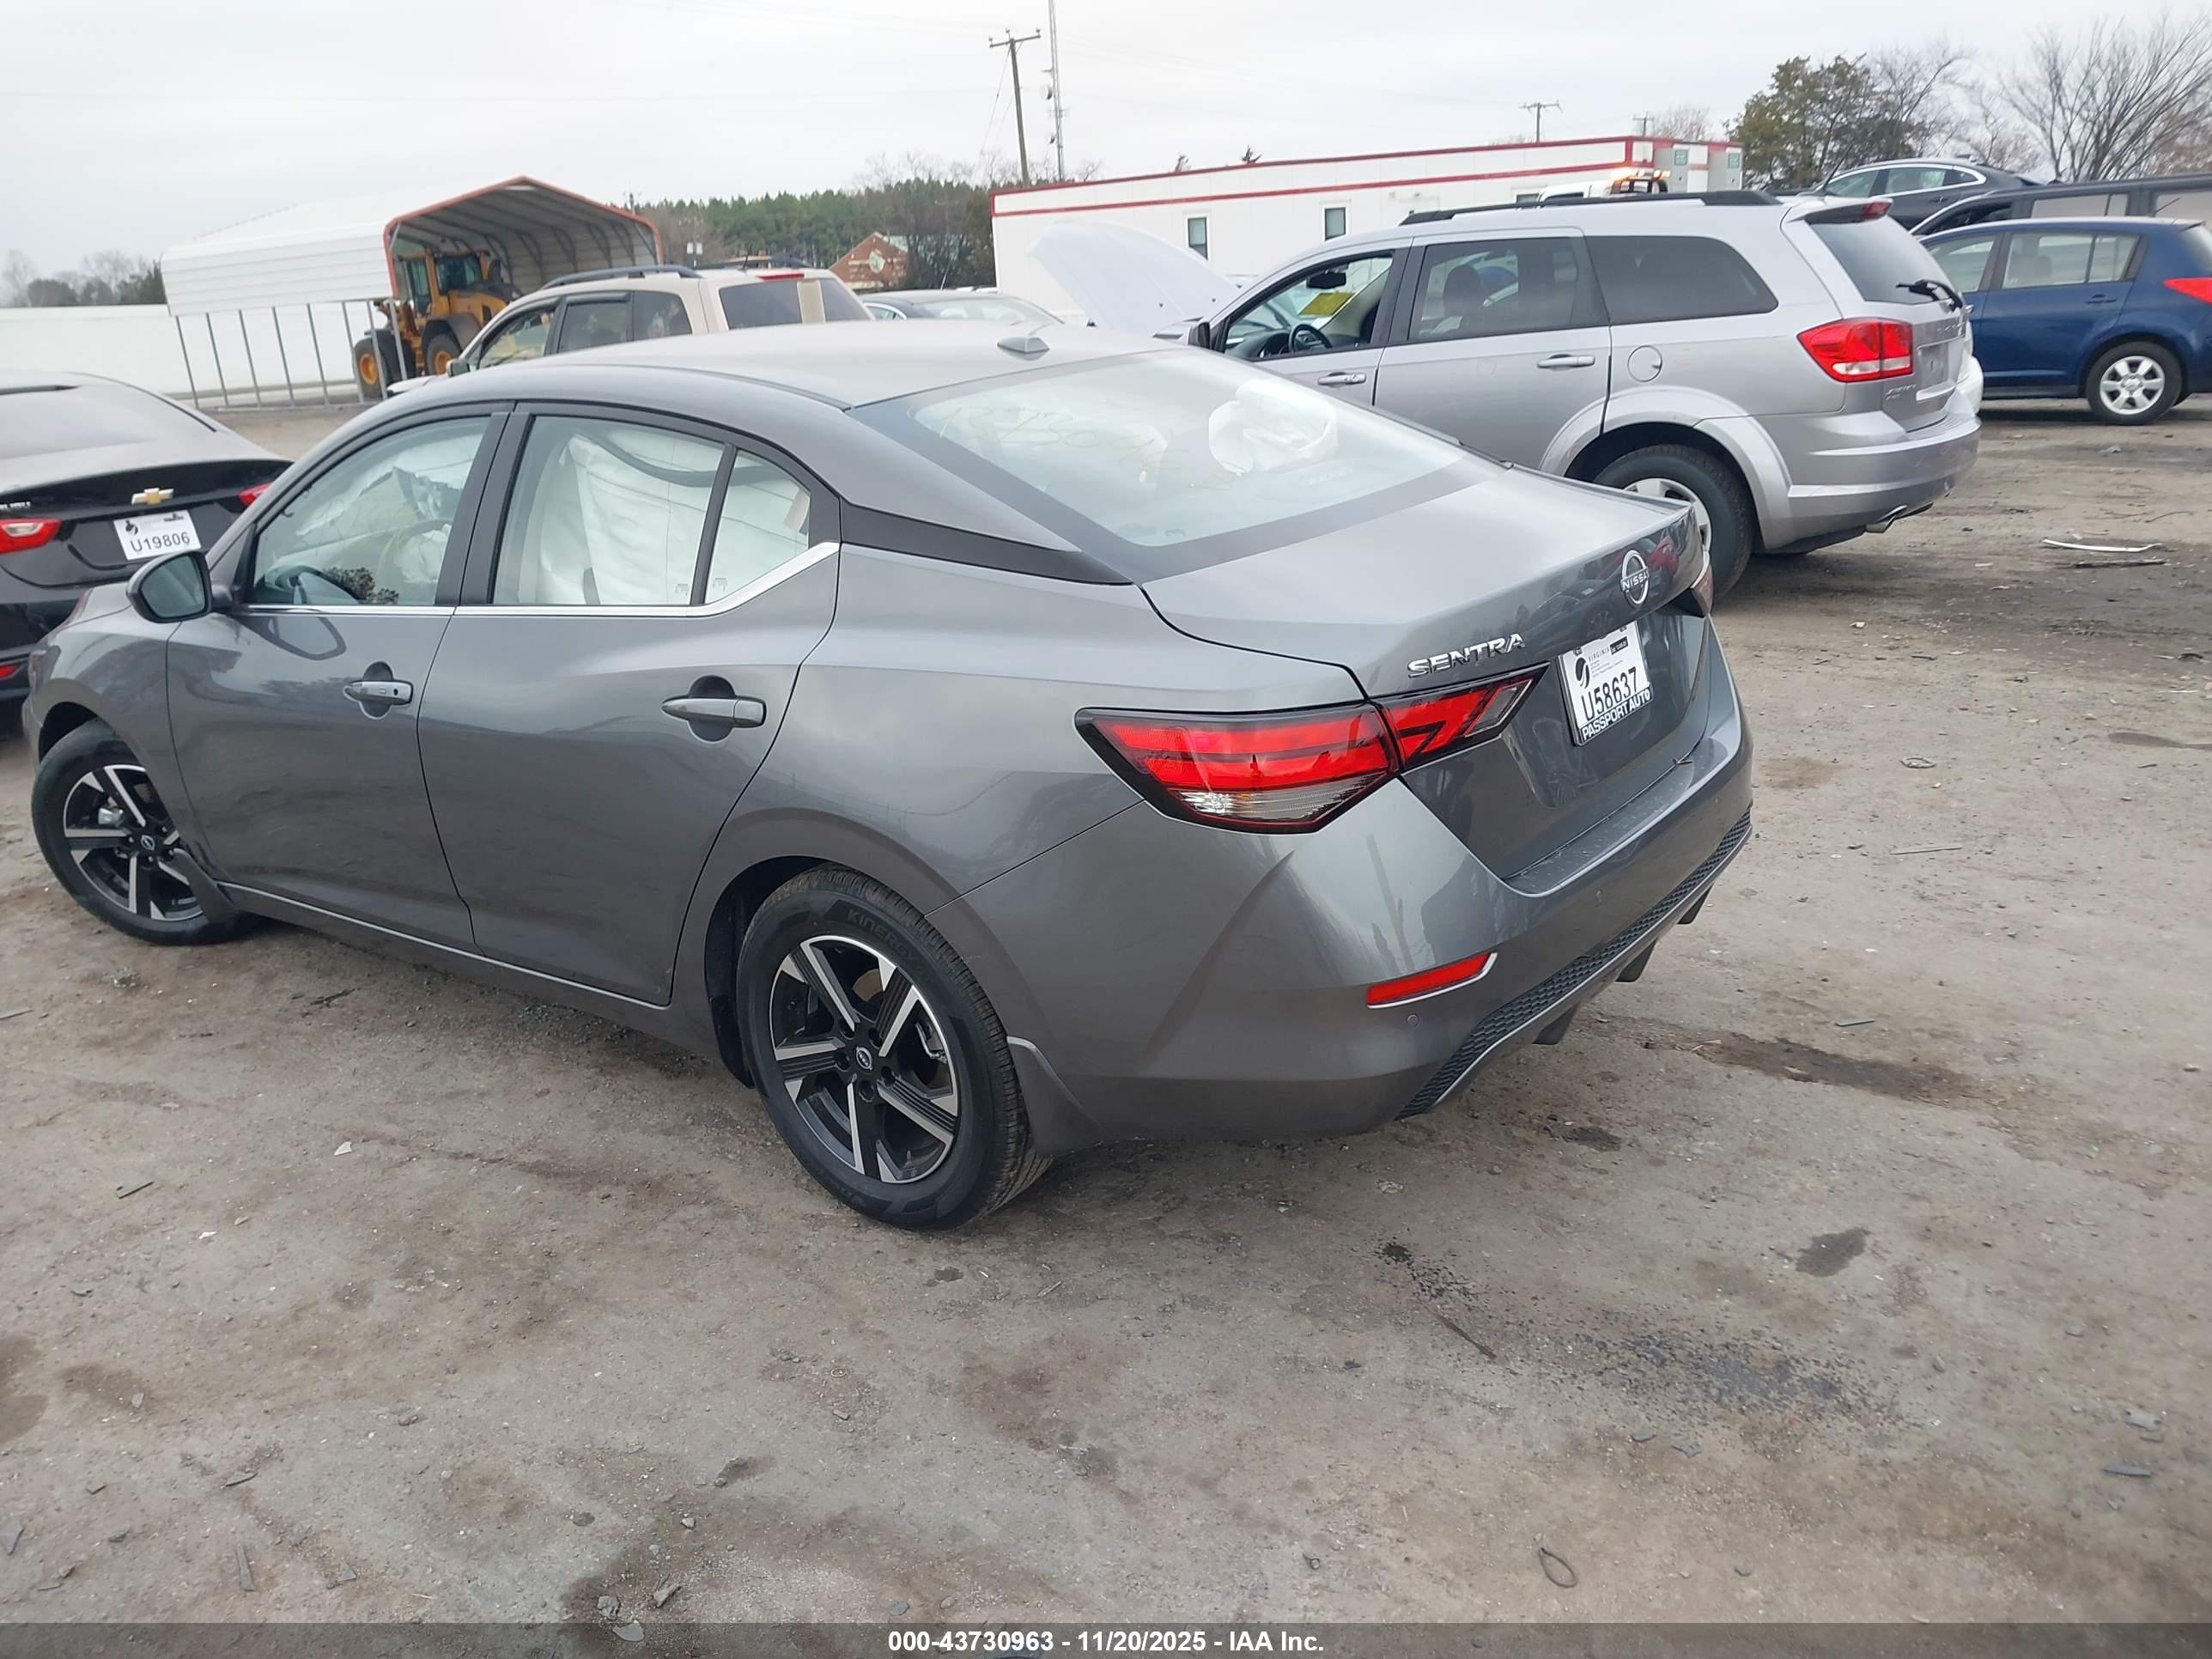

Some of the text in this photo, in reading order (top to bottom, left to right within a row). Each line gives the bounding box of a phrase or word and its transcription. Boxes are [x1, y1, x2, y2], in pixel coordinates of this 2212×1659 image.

[131, 532, 190, 552] U19806
[1407, 633, 1525, 678] SENTRA
[1589, 646, 1610, 662] VIRGINIA
[1582, 666, 1638, 720] U58637
[1582, 689, 1650, 740] PASSPORT AUTO
